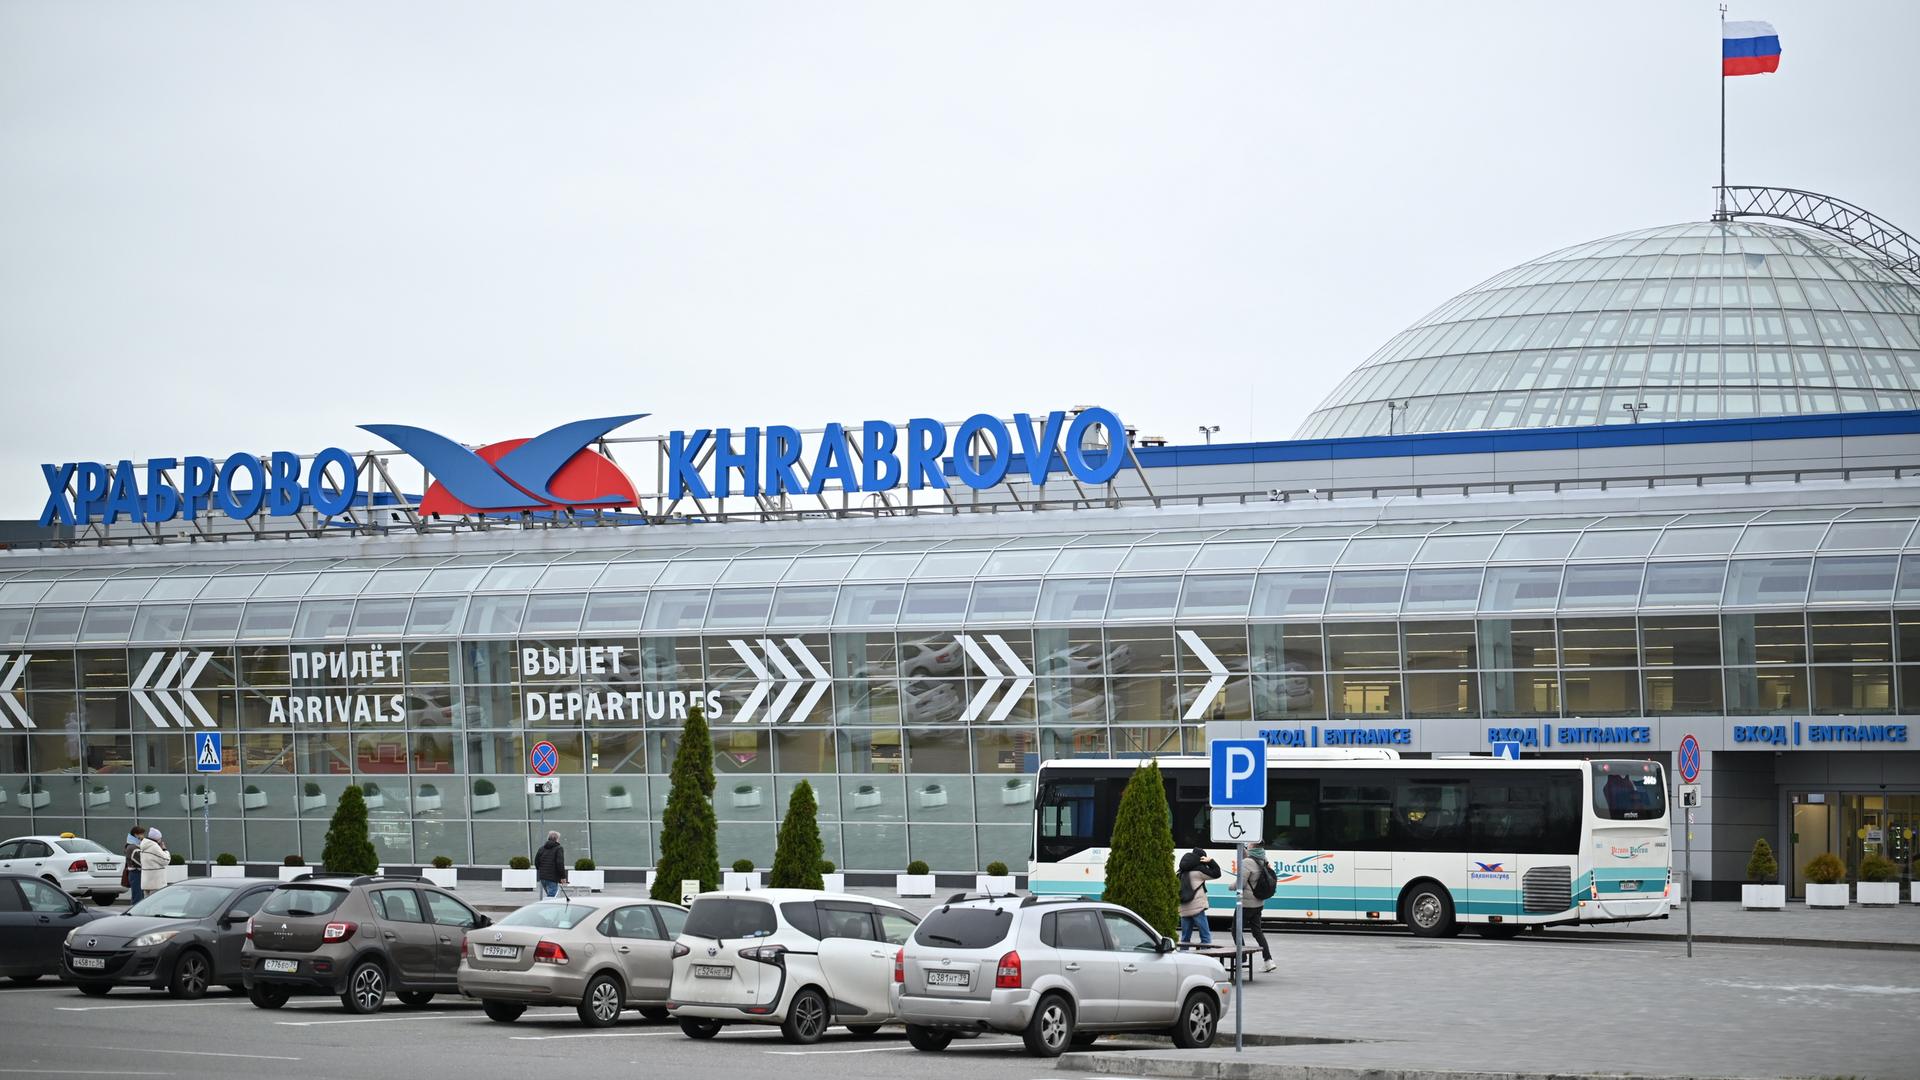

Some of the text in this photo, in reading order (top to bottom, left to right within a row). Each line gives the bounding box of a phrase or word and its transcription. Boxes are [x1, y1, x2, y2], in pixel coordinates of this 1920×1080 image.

[668, 407, 1127, 499] KHRABROVO
[39, 447, 358, 527] ХРАБРОВО
[291, 644, 402, 679] ПРИЛЁТ
[523, 646, 624, 676] ВЫЛЕТ
[269, 695, 406, 723] ARRIVALS
[527, 690, 723, 721] DEPARTURES
[1259, 729, 1306, 747] ВХОД
[1324, 728, 1411, 744] ENTRANCE
[1488, 727, 1538, 747] ВХОД
[1558, 726, 1650, 743] ENTRANCE
[1734, 725, 1787, 746] ВХОД
[1808, 725, 1907, 743] ENTRANCE
[1225, 746, 1256, 799] P
